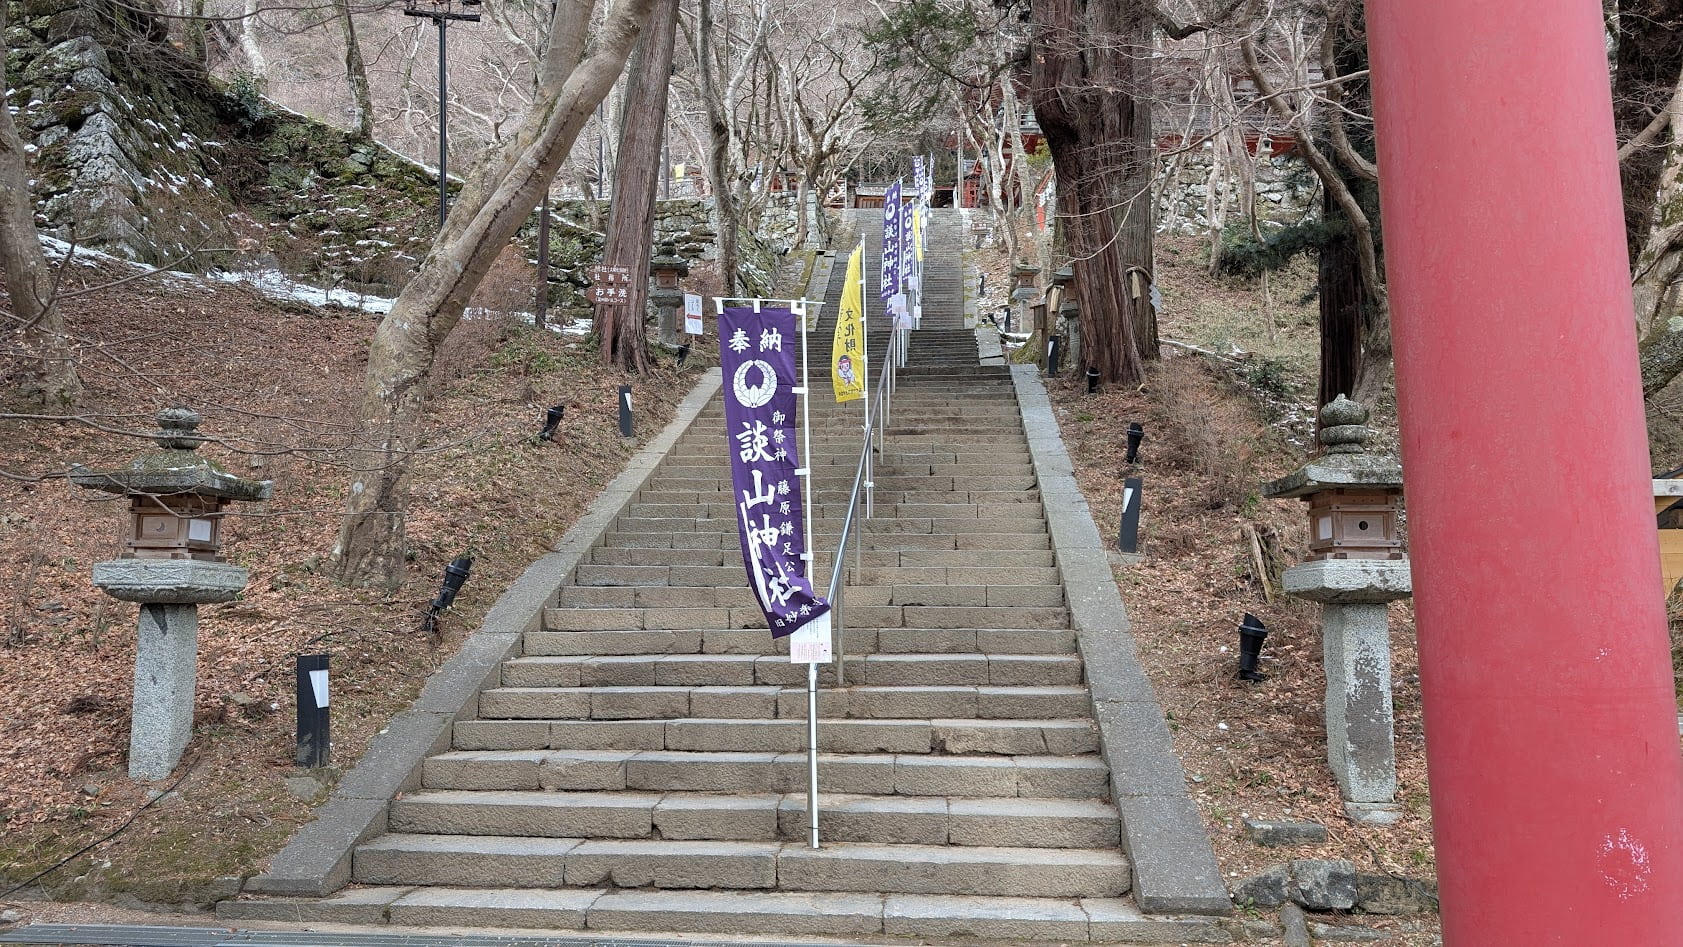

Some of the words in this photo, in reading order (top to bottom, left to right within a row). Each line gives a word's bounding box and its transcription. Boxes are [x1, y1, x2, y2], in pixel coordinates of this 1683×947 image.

[596, 287, 627, 298] お手洗
[728, 327, 782, 354] 奉納
[772, 410, 787, 462] 御祭神
[736, 420, 802, 607] 談山神社
[777, 480, 796, 573] 藤原鎌足公
